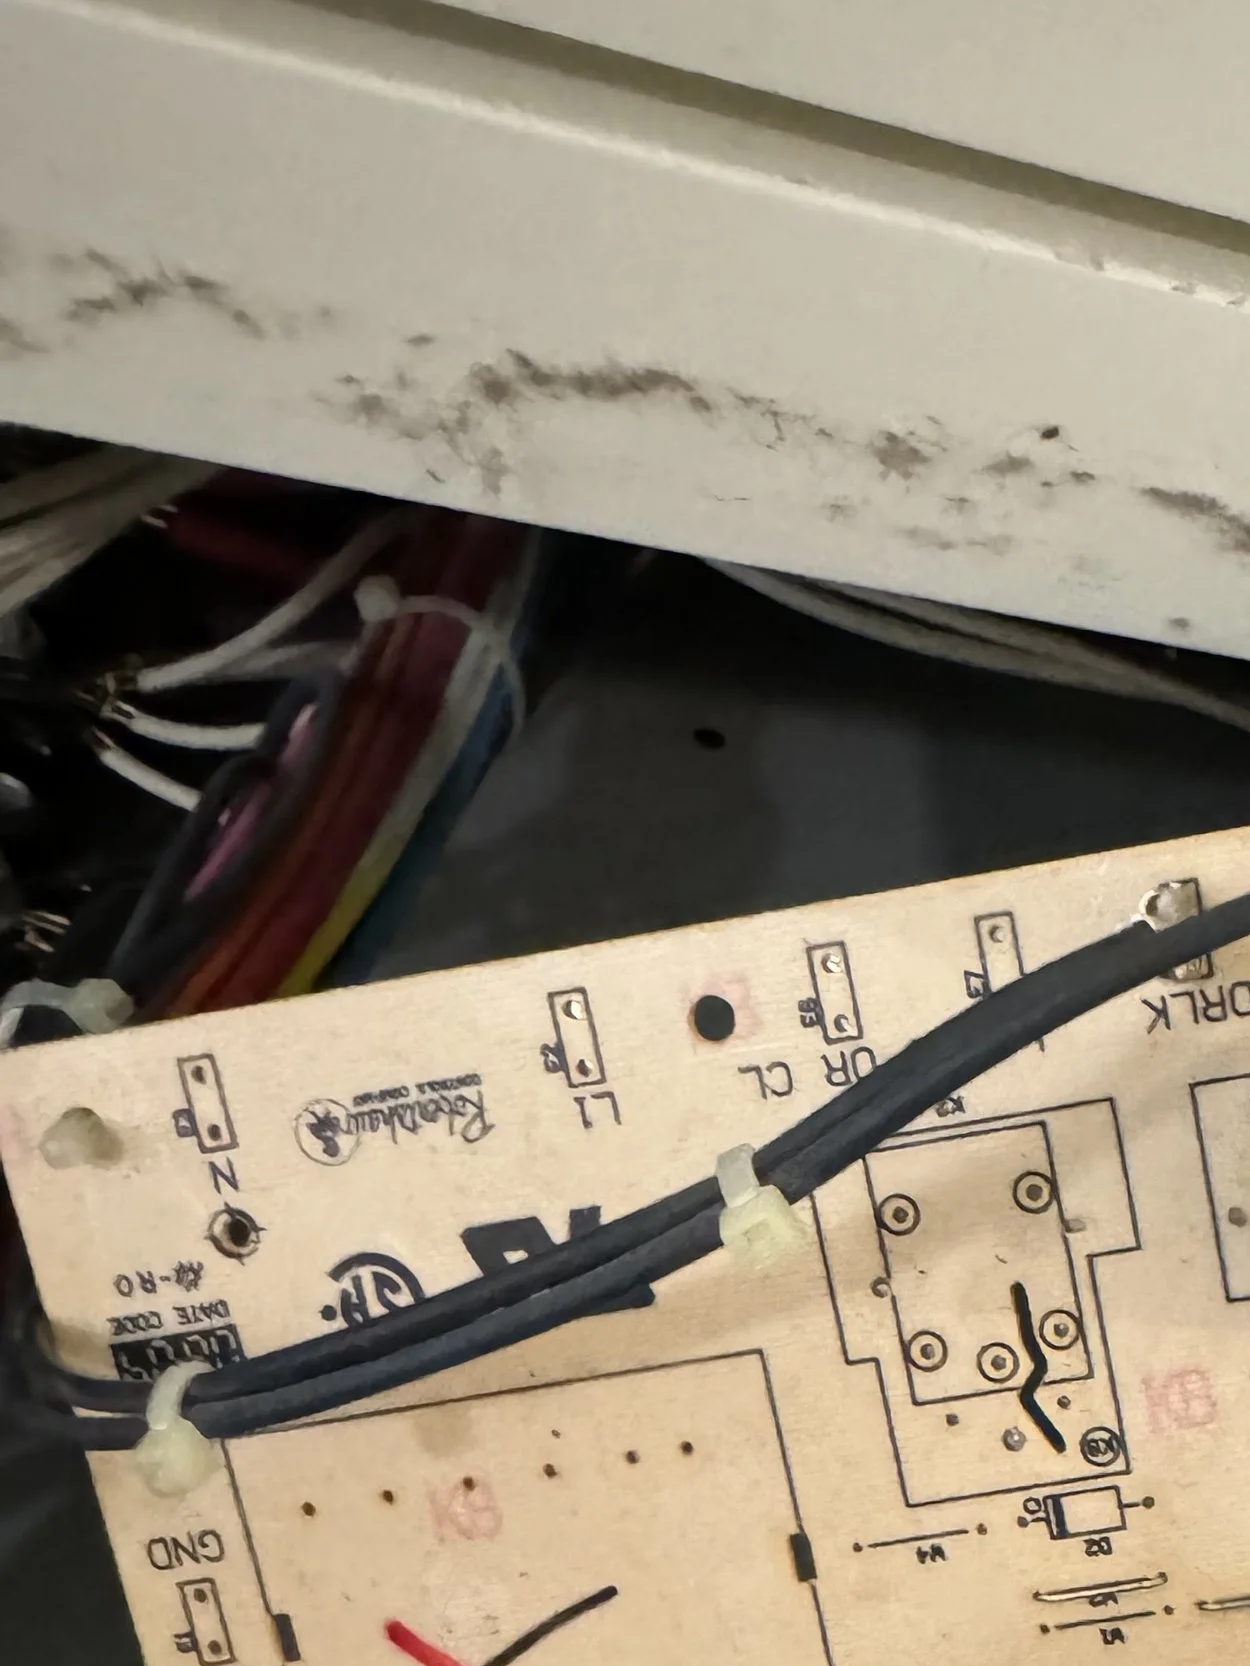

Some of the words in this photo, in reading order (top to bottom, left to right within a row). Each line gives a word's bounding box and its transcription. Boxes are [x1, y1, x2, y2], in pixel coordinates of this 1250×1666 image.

[738, 1061, 792, 1099] CL
[209, 1159, 240, 1194] N
[147, 1529, 225, 1570] GND
